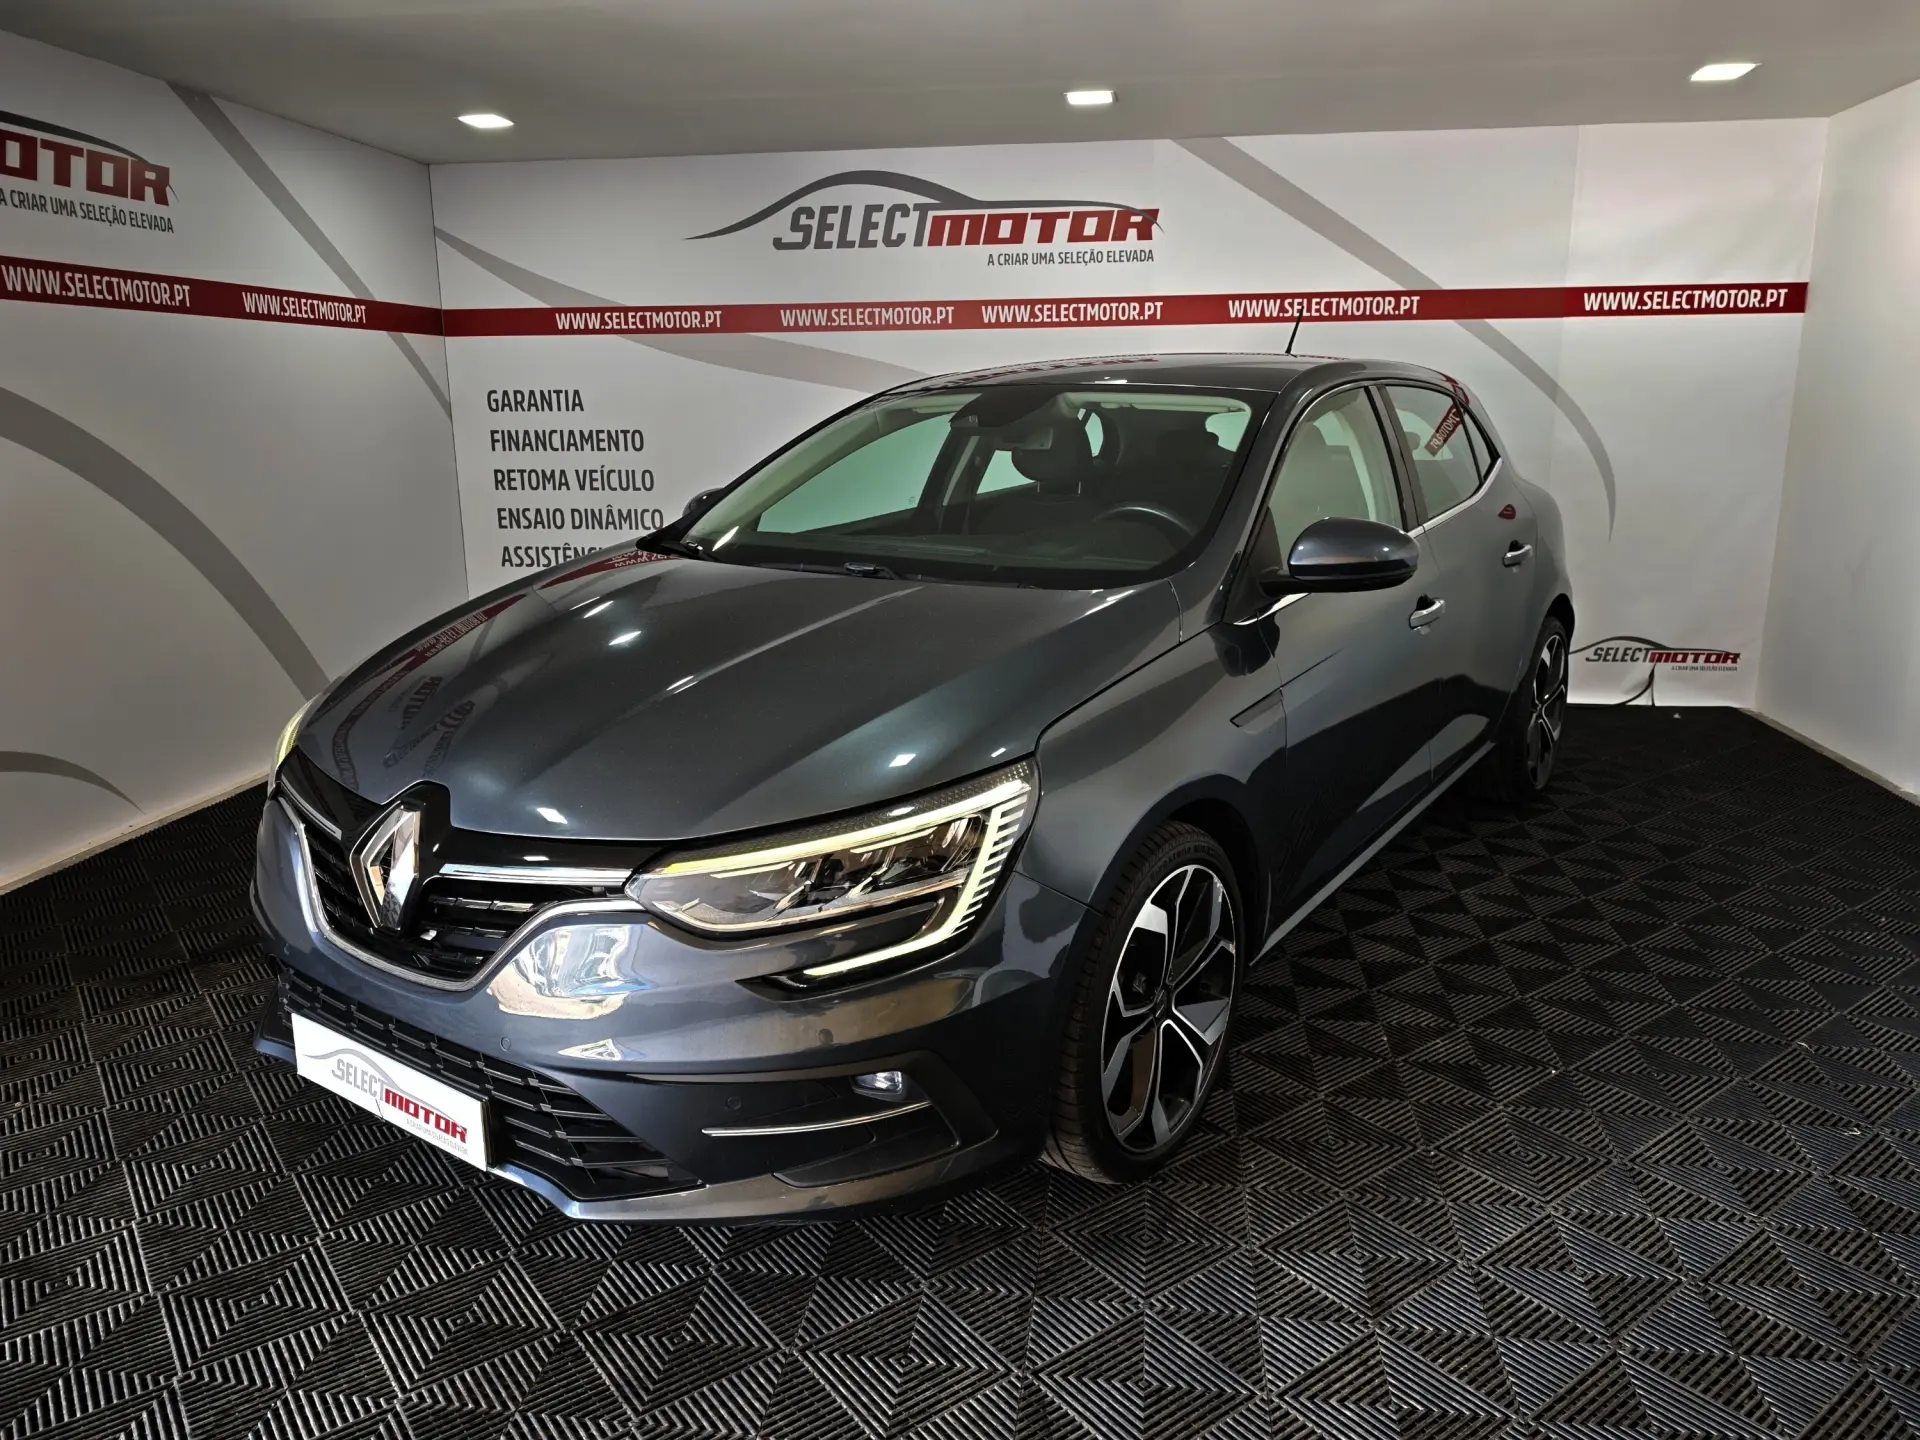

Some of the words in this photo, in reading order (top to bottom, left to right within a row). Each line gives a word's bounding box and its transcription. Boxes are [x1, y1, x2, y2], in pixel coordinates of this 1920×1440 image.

[0, 187, 8, 206] A
[10, 189, 48, 213] CRIAR
[50, 196, 78, 218] UMA
[80, 202, 127, 227] SELEÇÃO
[129, 210, 174, 234] ELEVADA
[987, 253, 995, 266] A
[997, 252, 1029, 266] CRIAR
[1031, 251, 1055, 265] UMA
[1058, 248, 1103, 267] SELEÇÃO
[1106, 249, 1154, 263] ELEVADA
[1, 264, 190, 307] WWW.SELECTMOTOR.PT
[241, 291, 366, 323] WWW.SELECTMOTOR.PT
[1228, 296, 1420, 318] WWW.SELECTMOTOR.PT
[1583, 288, 1788, 311] WWW.SELECTMOTOR.PT
[555, 310, 722, 329] WWW.SELECTMOTOR.PT
[780, 306, 955, 327] WWW.SELECTMOTOR.PT
[981, 301, 1164, 323] WWW.SELECTMOTOR.PT
[487, 389, 584, 412] GARANTIA
[490, 429, 644, 452] FINANCIAMENTO
[493, 468, 571, 491] RETOMA
[575, 464, 654, 492] VEÍCULO
[497, 507, 565, 530] ENSAIO
[570, 504, 664, 531] DINÂMICO
